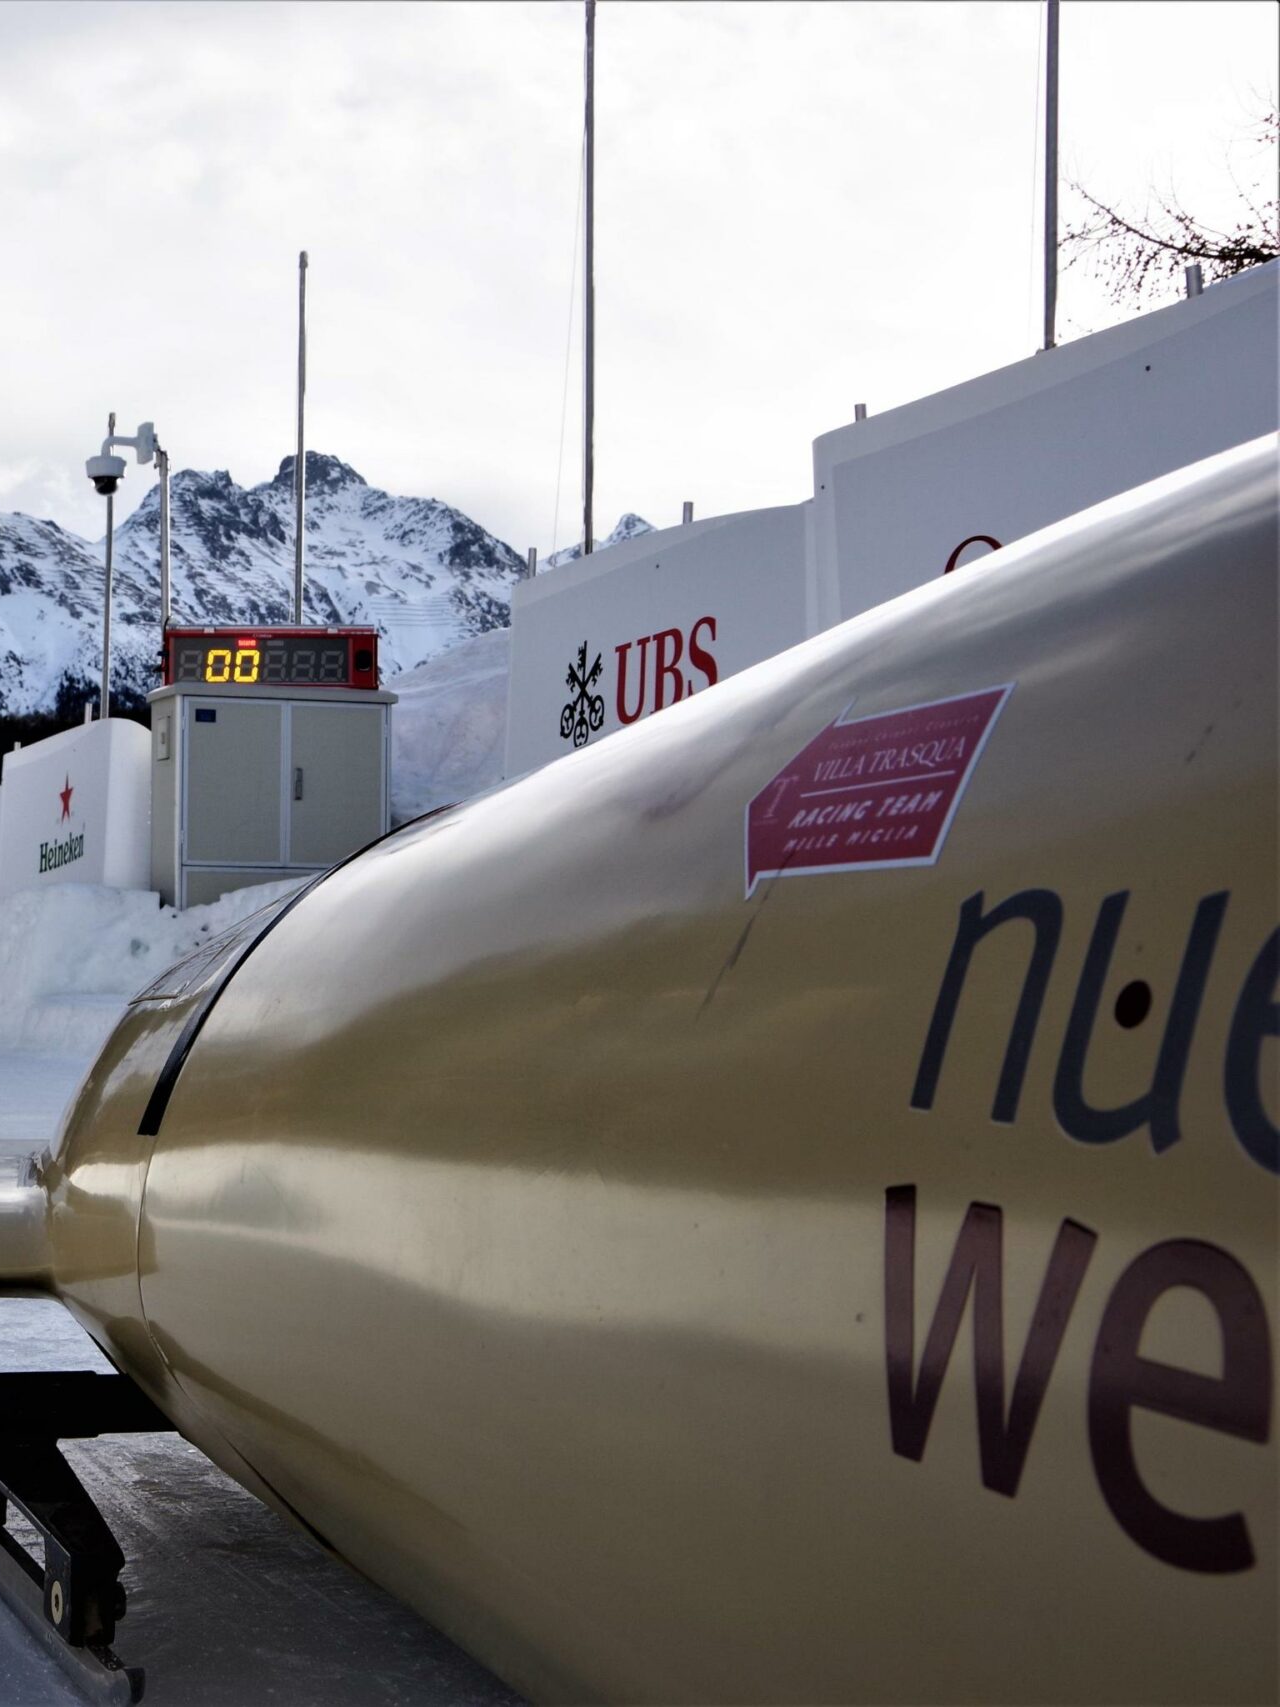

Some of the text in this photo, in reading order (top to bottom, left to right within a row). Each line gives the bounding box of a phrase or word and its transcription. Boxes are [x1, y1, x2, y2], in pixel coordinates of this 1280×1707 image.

[205, 649, 261, 683] 00
[614, 616, 719, 725] UBS
[813, 735, 967, 782] VILLA TRASQUA
[787, 789, 944, 830] RACING TEAM
[38, 831, 84, 874] Heineken
[782, 824, 919, 852] MILLE MIGLIA
[884, 1182, 1274, 1575] we
